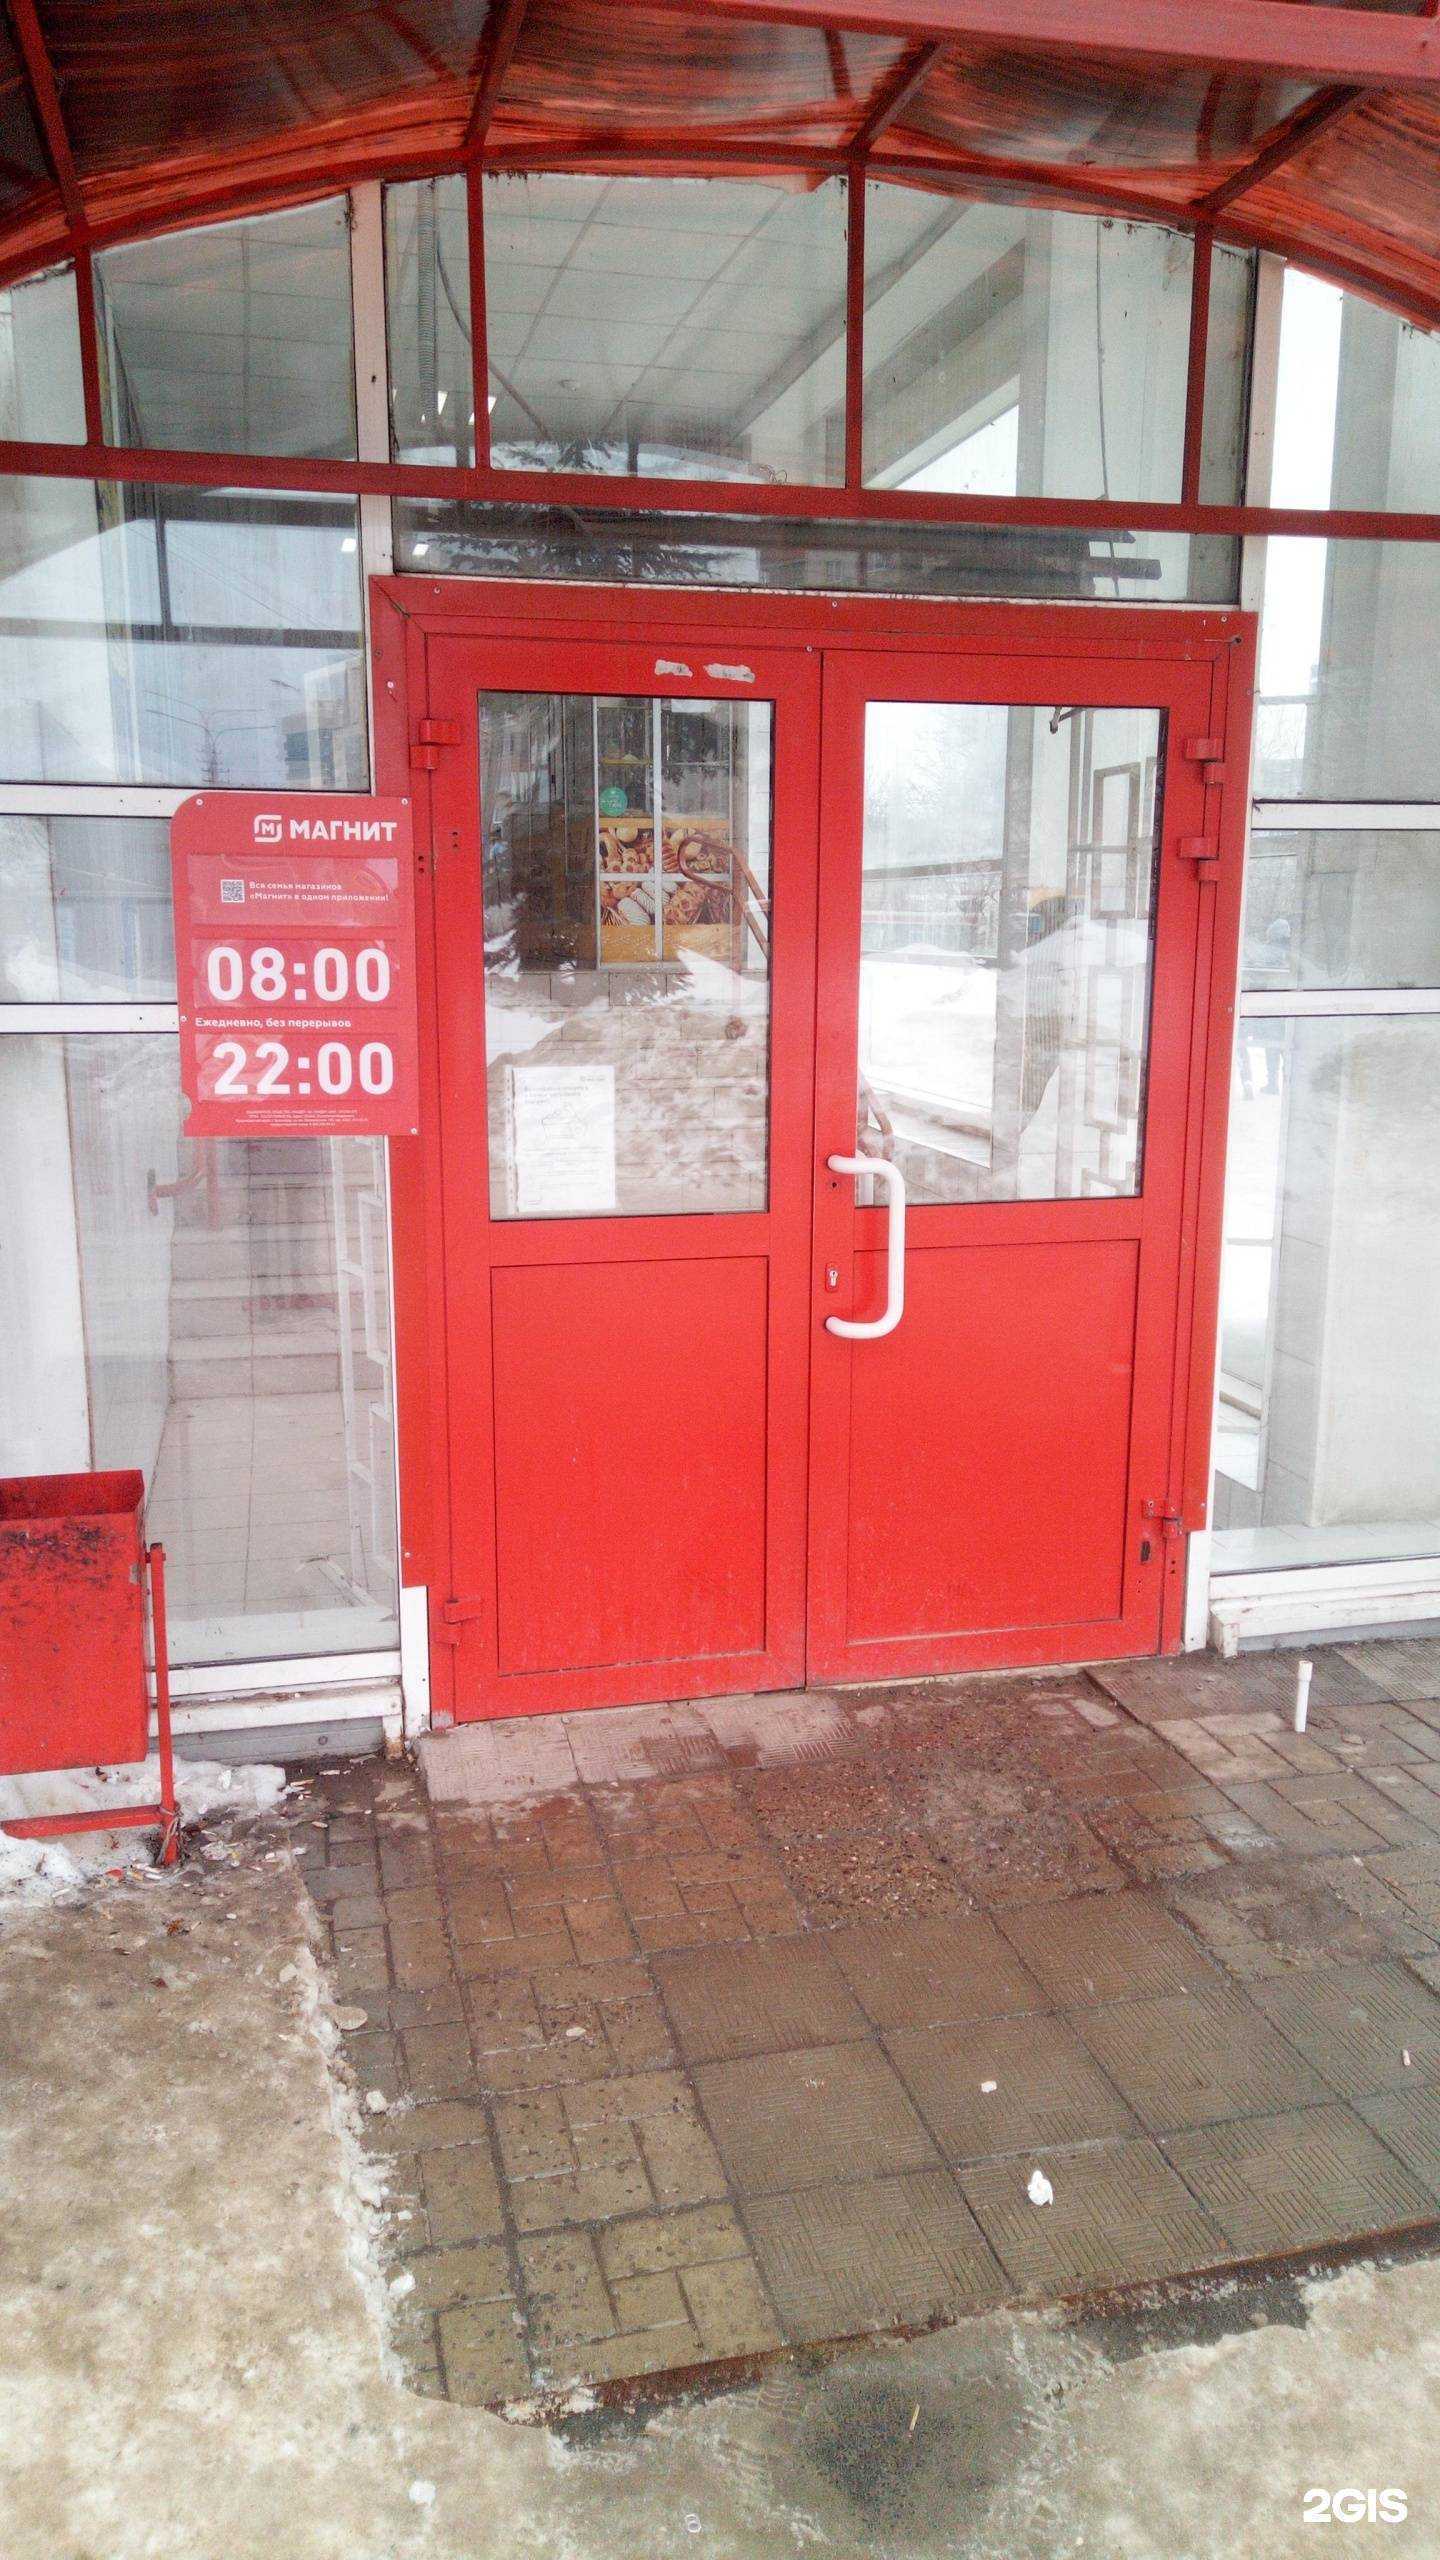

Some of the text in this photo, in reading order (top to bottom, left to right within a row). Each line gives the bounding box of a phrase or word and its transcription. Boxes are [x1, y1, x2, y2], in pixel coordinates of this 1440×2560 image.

[289, 819, 398, 842] МАГНИТ
[249, 881, 266, 889] Вся
[295, 882, 342, 890] магазинов
[301, 894, 330, 902] одном
[207, 946, 391, 1002] 08:00
[195, 1017, 352, 1028] Ежедневно, без перерывов
[212, 1041, 394, 1095] 22:00
